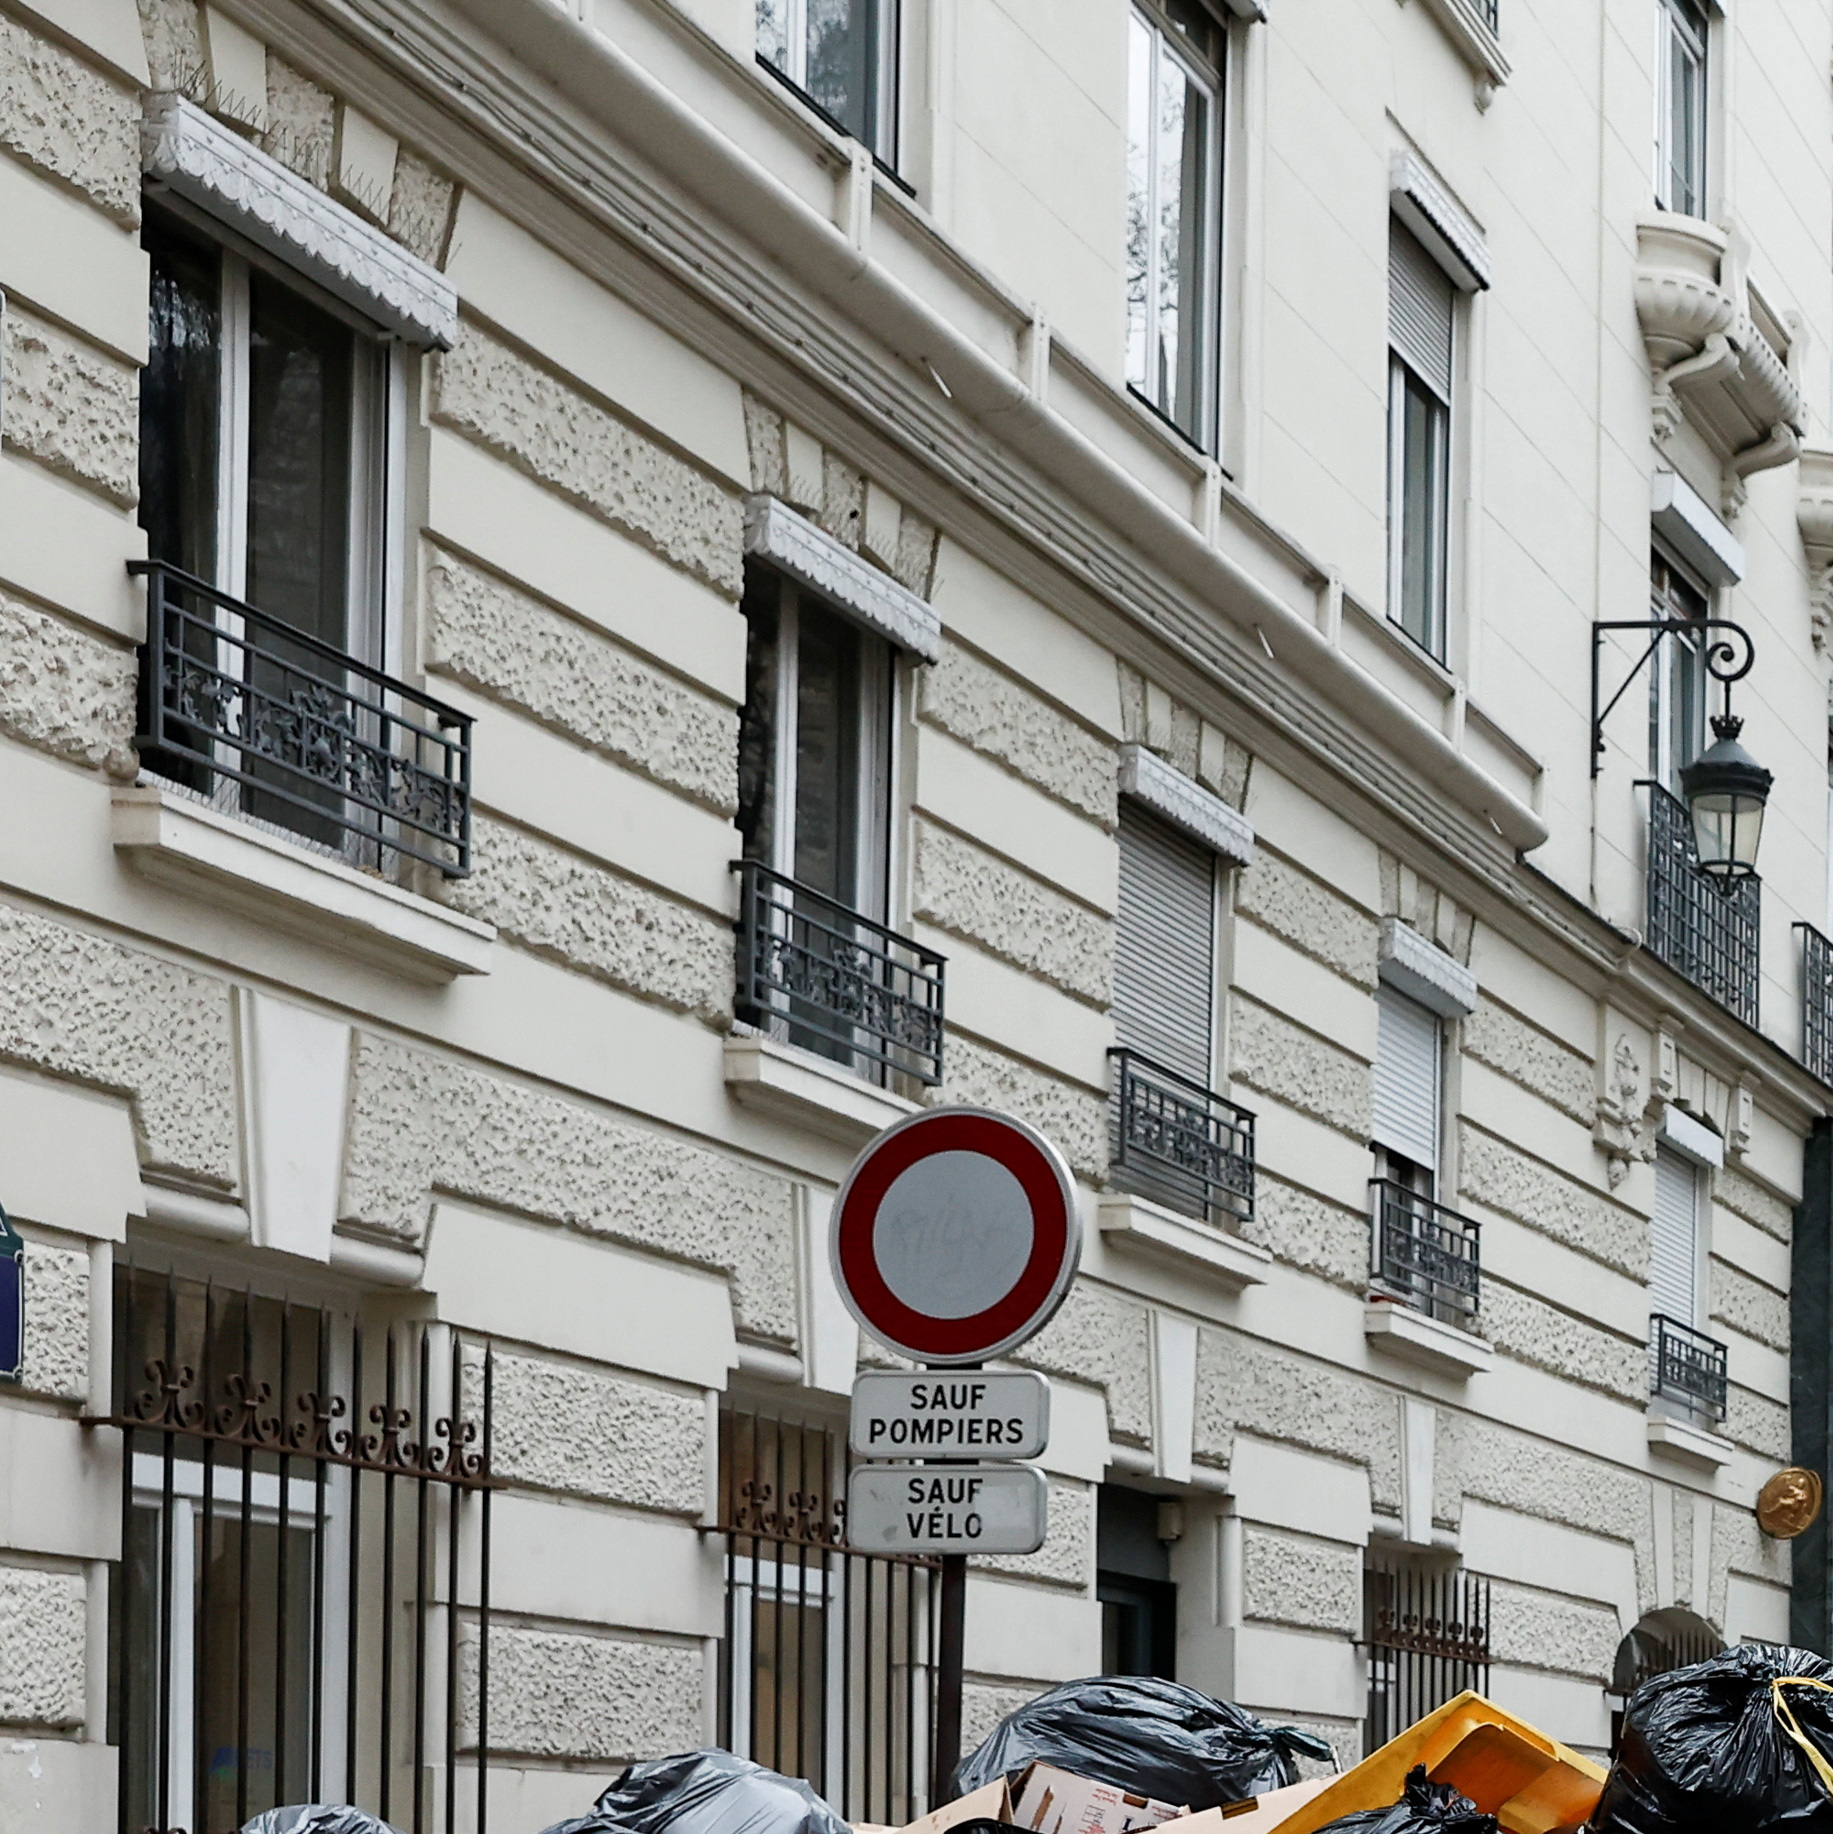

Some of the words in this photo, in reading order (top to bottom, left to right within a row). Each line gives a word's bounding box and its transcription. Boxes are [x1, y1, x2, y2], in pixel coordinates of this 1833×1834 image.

[910, 1384, 986, 1410] SAUF
[869, 1417, 1024, 1444] POMPIERS
[908, 1478, 983, 1504] SAUF
[907, 1506, 982, 1539] VÉLO
